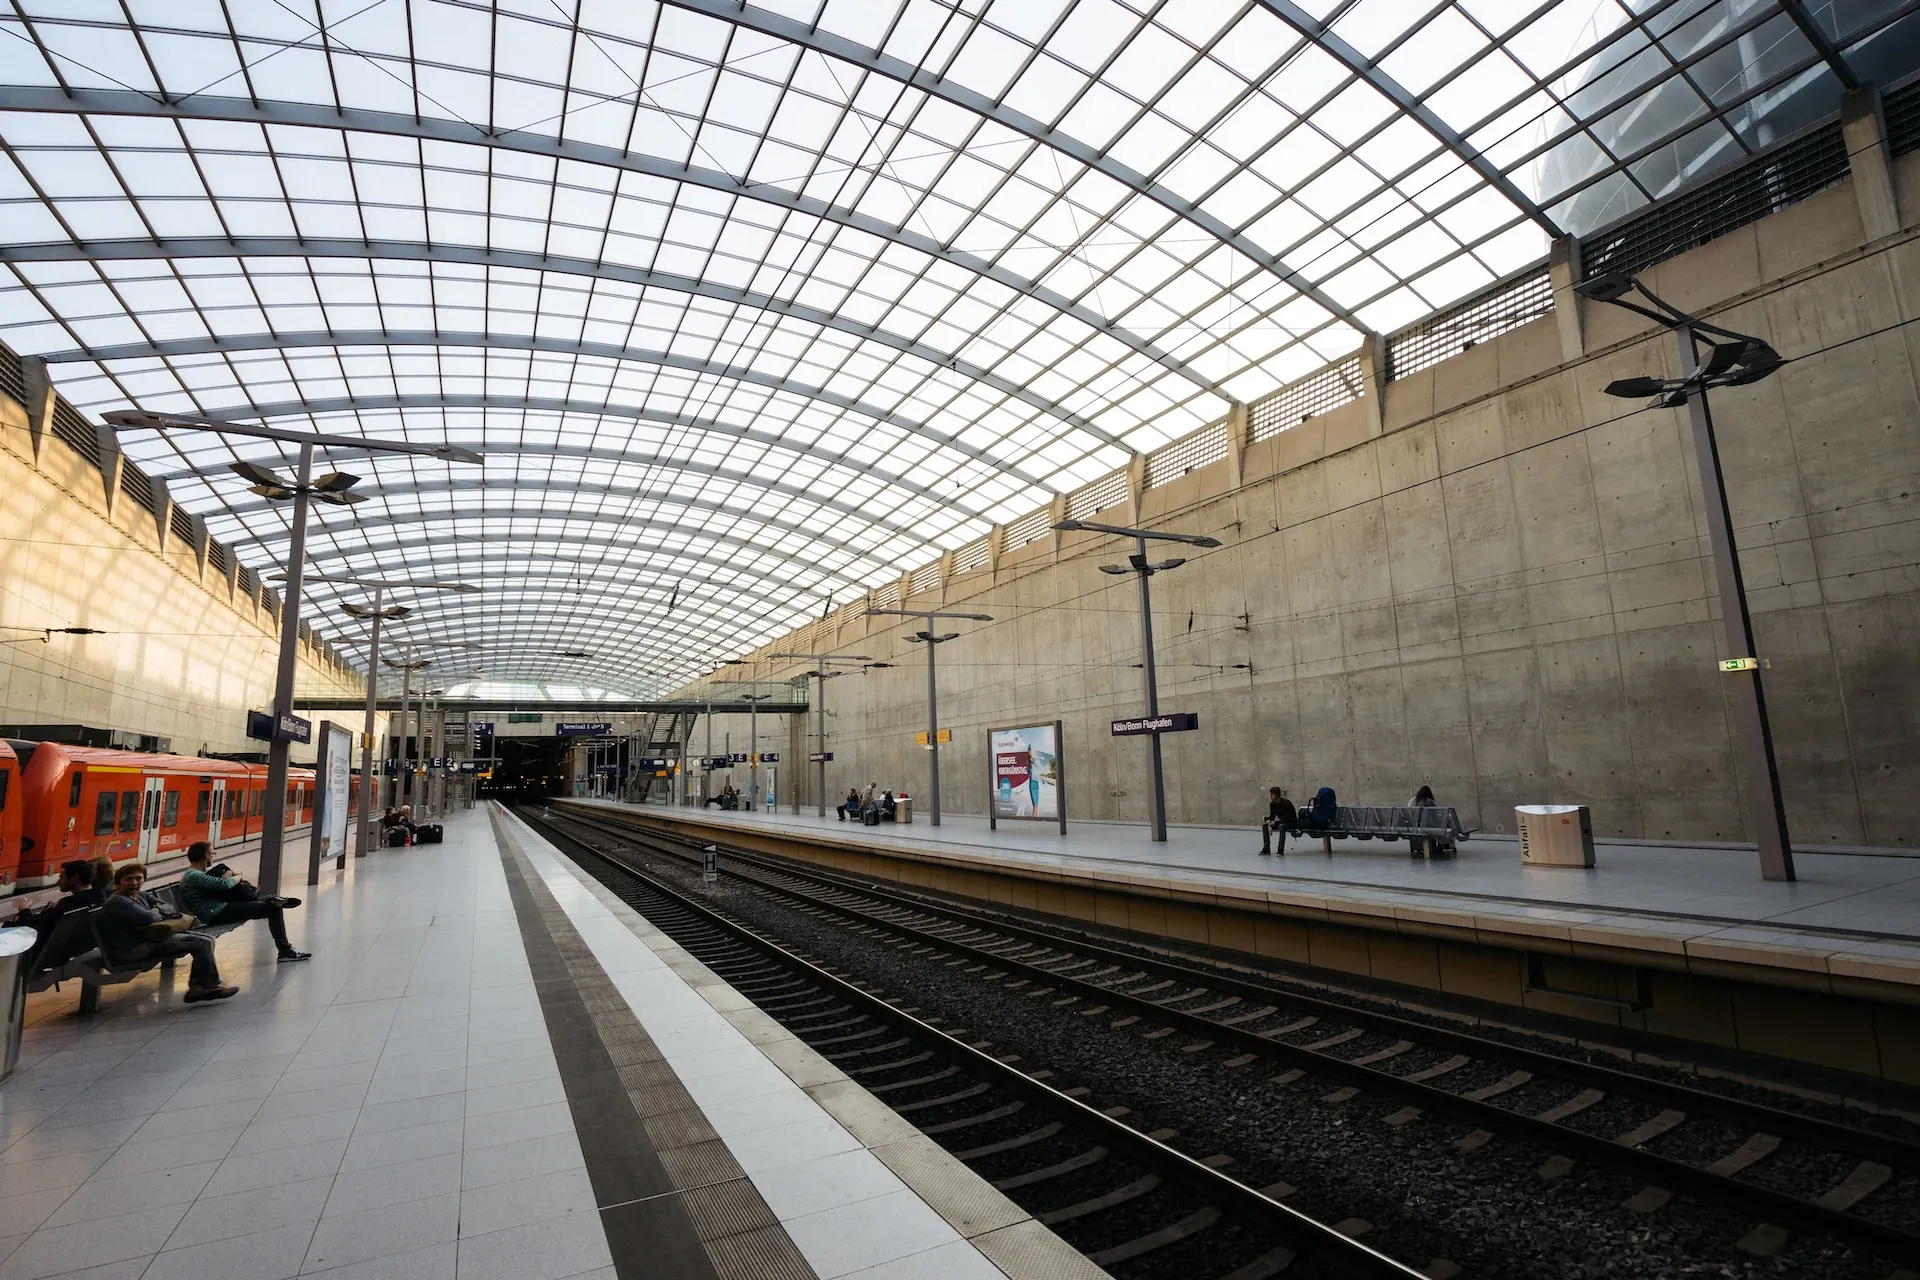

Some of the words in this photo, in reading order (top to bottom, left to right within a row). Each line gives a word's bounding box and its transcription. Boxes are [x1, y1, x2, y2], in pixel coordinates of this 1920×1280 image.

[1113, 721, 1142, 732] Köln/Bonn
[1143, 717, 1172, 730] Flughafen
[433, 758, 440, 767] E
[446, 758, 453, 767] 2
[728, 754, 734, 762] 3
[1520, 825, 1530, 857] Abfall
[705, 854, 716, 871] H
